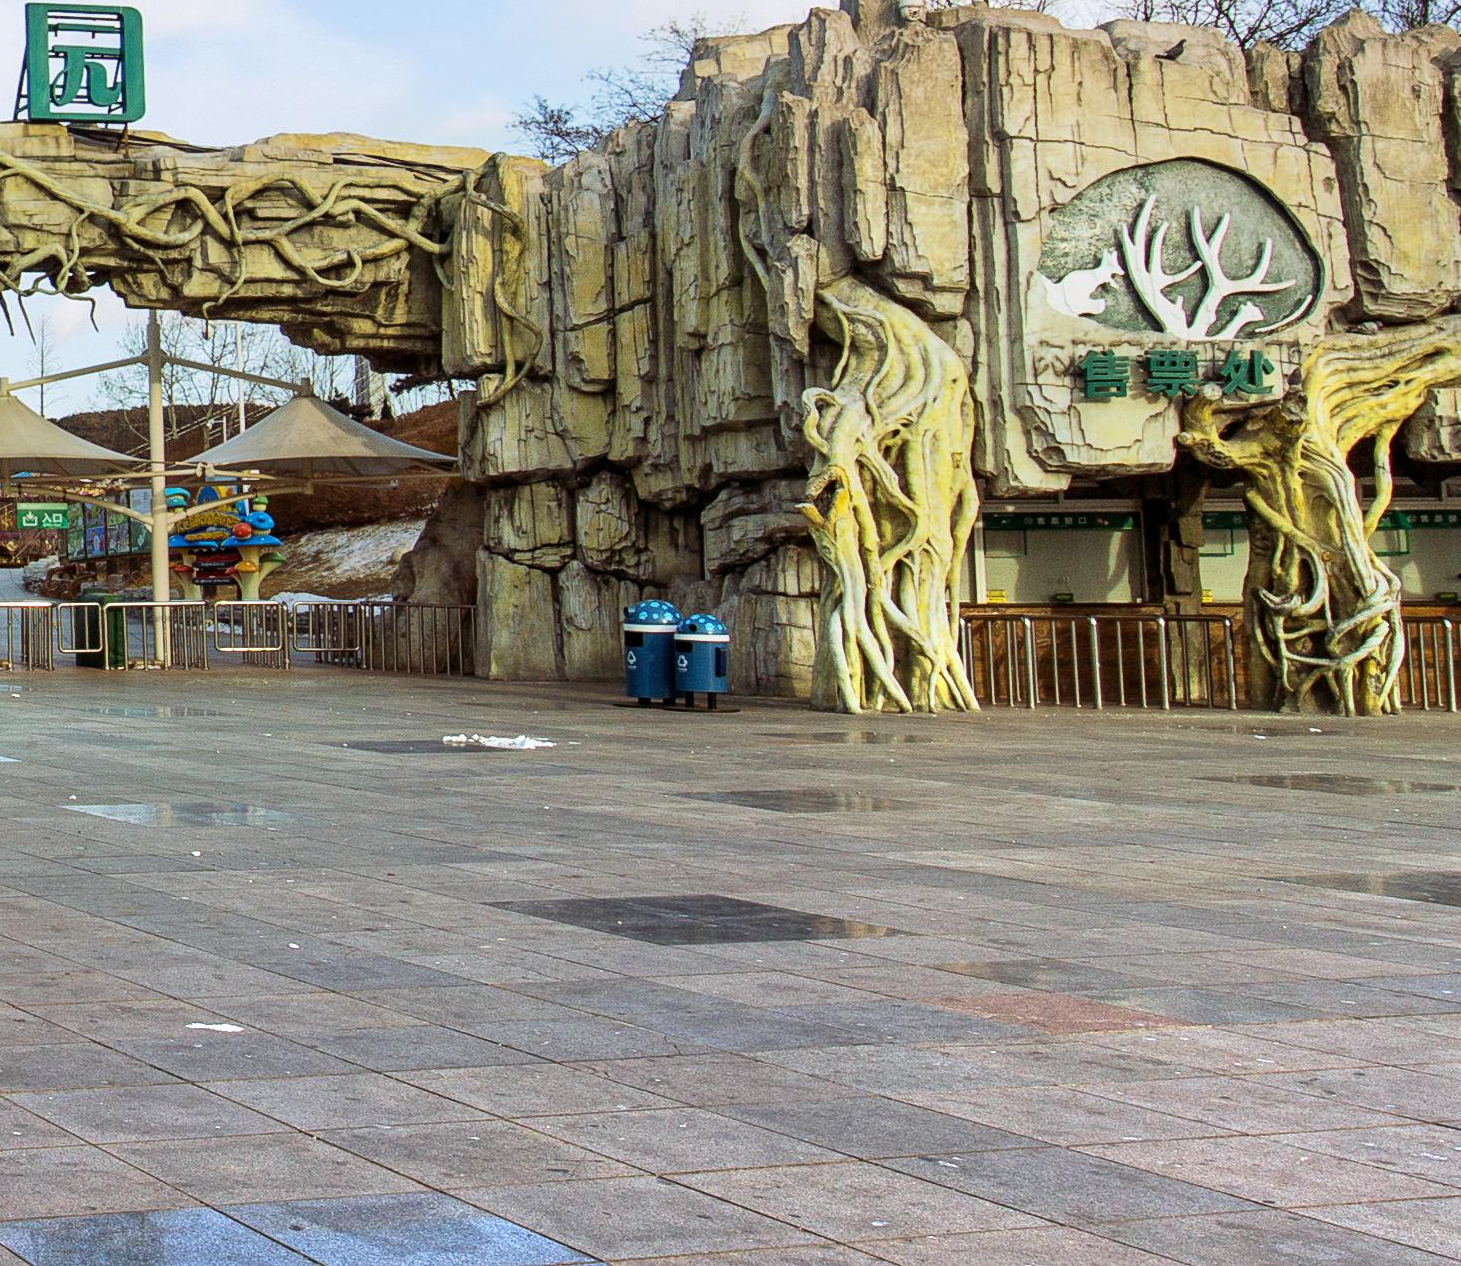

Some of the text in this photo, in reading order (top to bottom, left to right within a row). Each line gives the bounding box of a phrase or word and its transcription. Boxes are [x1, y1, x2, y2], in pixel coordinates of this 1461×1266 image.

[1079, 349, 1274, 399] 售票处
[42, 513, 63, 523] 入口
